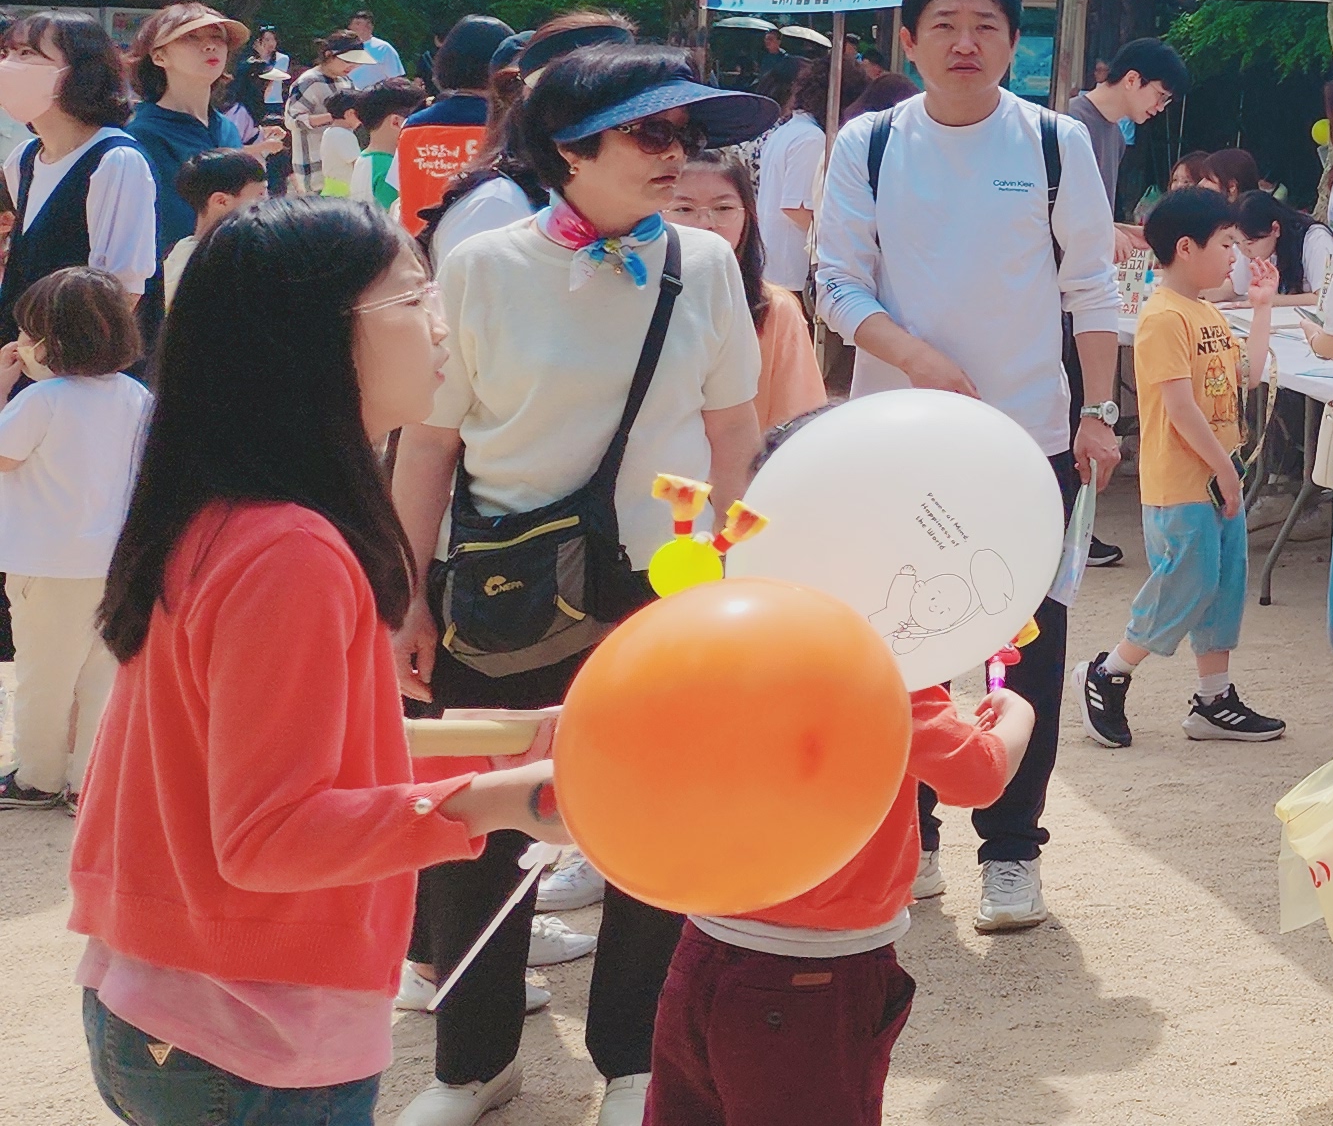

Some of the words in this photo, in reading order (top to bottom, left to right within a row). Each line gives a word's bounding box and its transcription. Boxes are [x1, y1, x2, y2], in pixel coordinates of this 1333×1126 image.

[993, 179, 1017, 187] Calvin
[1017, 180, 1035, 188] Klein
[920, 502, 951, 539] Happiness
[926, 527, 946, 550] World
